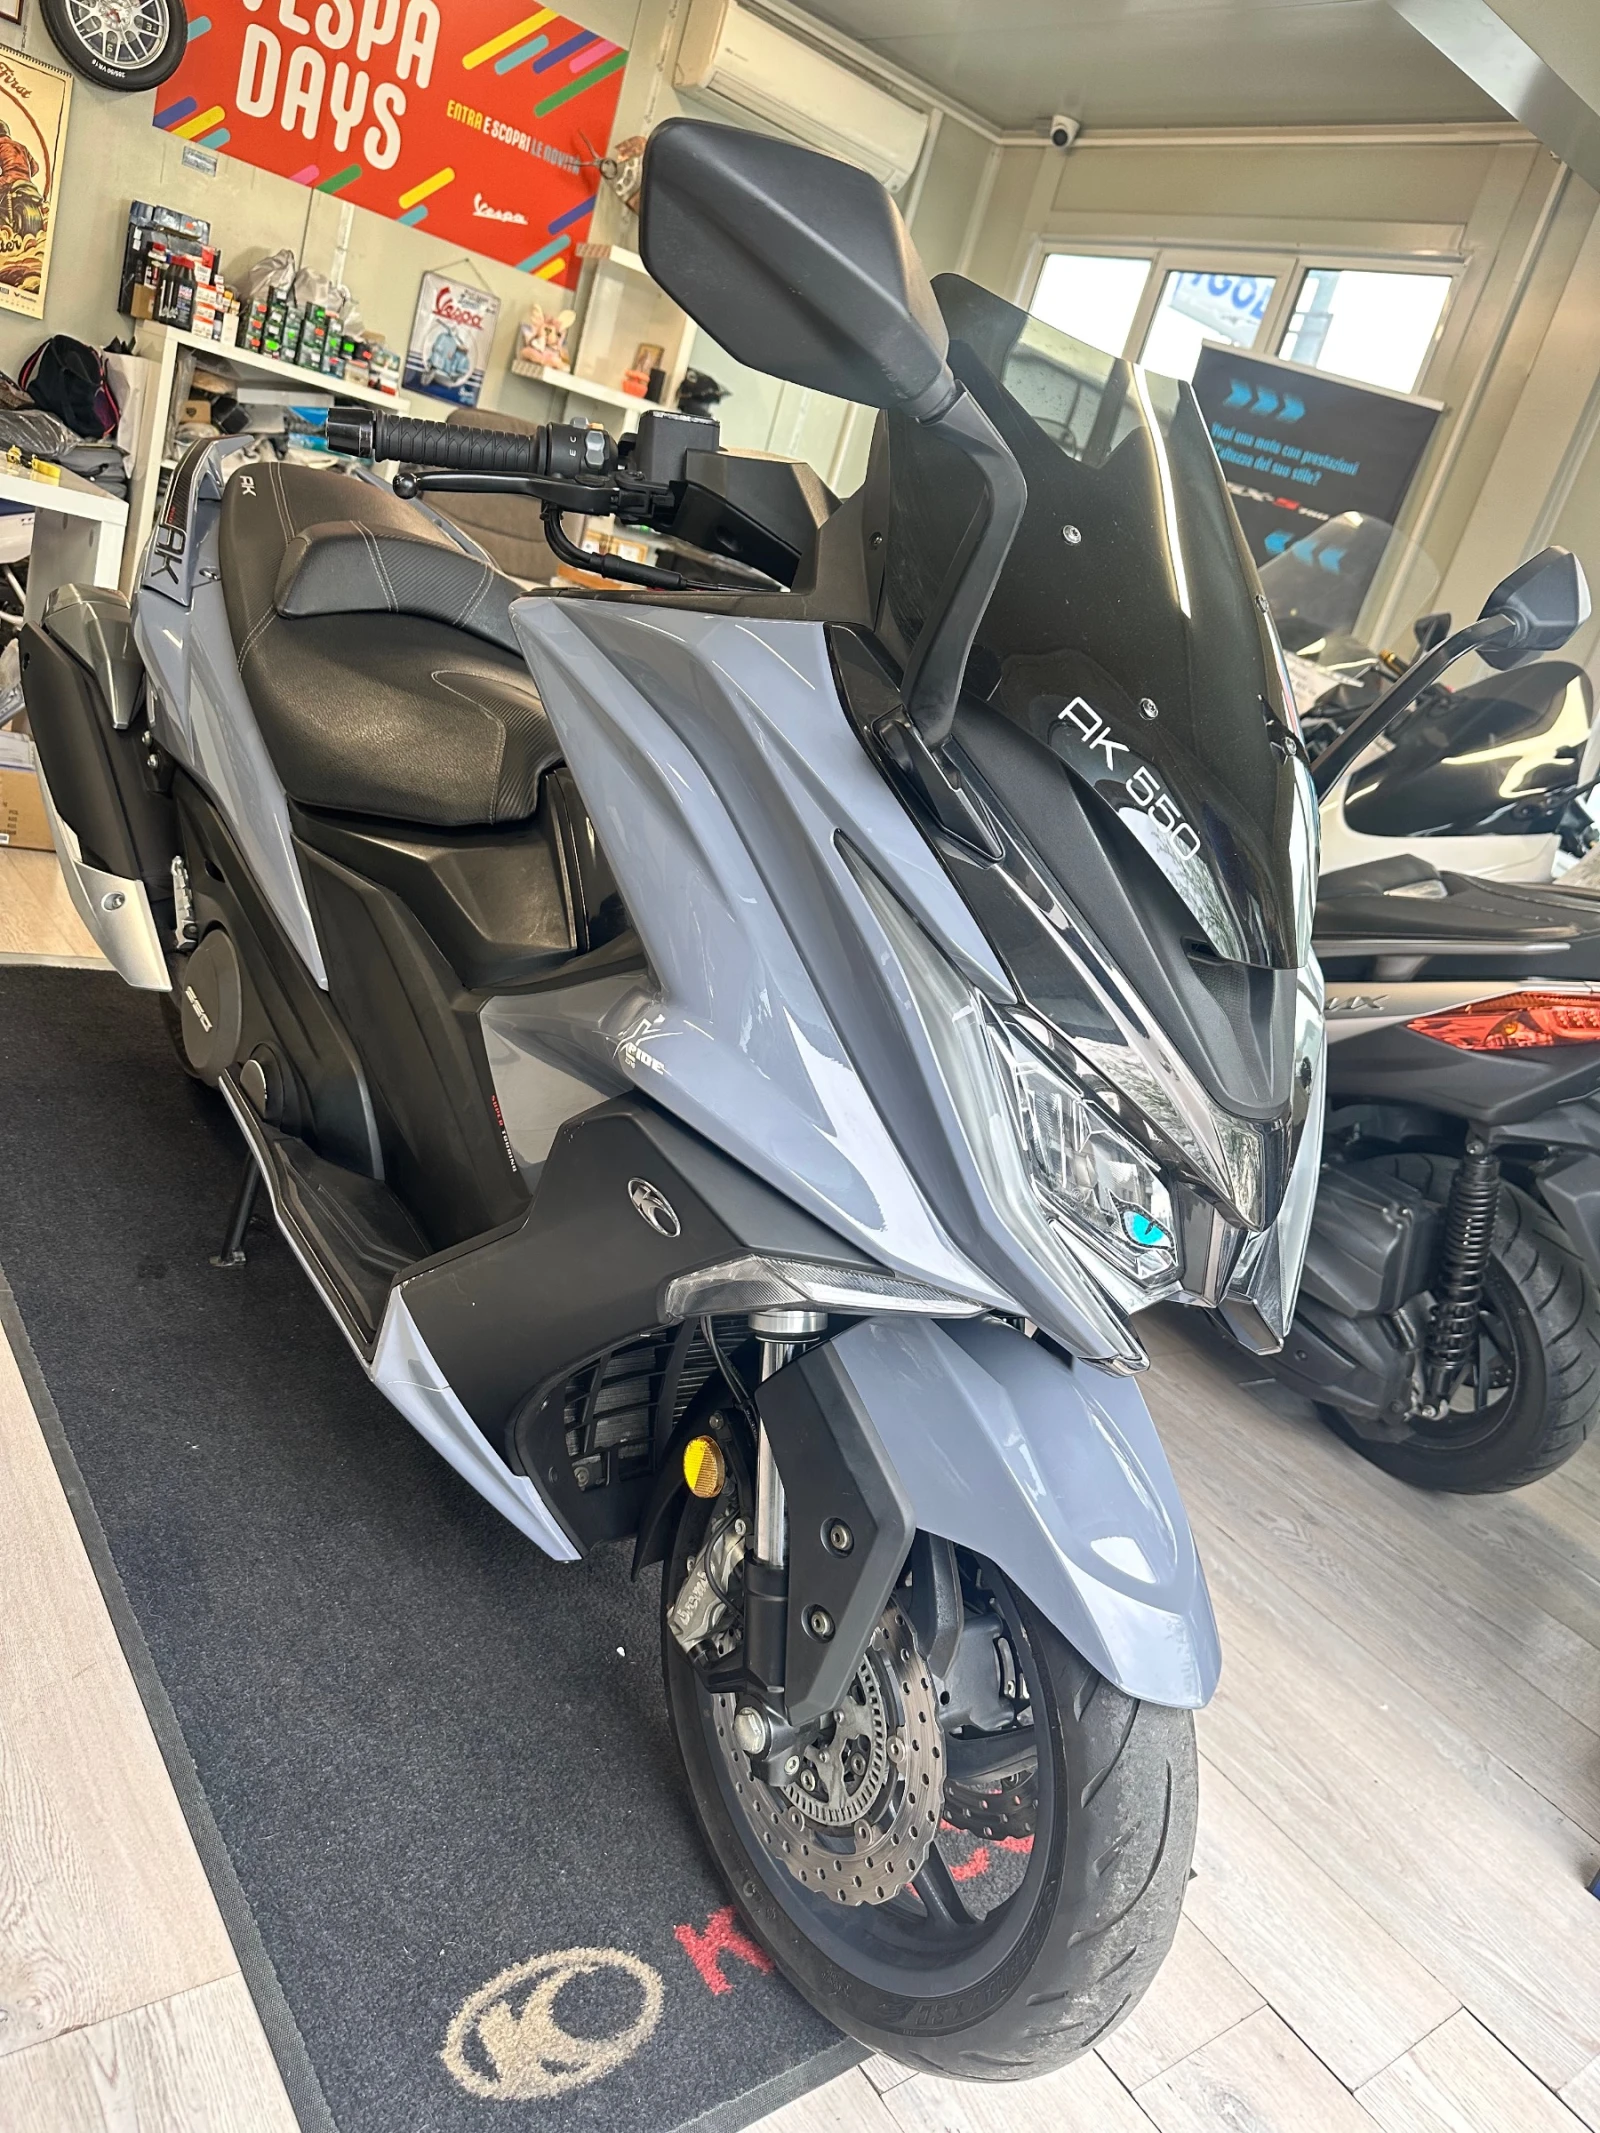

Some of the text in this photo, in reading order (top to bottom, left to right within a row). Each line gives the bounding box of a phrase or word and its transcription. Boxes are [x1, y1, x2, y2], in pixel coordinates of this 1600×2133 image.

[243, 0, 441, 89] SPA
[236, 23, 406, 170] DAYS
[446, 99, 484, 130] ENTRA
[483, 116, 492, 134] E
[491, 120, 532, 152] SCOPRI
[530, 138, 543, 158] LE
[472, 193, 529, 225] Vespa
[432, 286, 485, 330] Vespa
[1234, 430, 1255, 446] una
[1254, 436, 1282, 454] moto
[1281, 444, 1302, 459] con
[1300, 450, 1360, 476] prestazioni
[1254, 455, 1273, 472] del
[1271, 462, 1292, 478] suo
[240, 475, 257, 497] AK
[151, 524, 188, 585] AK
[1057, 696, 1201, 860] AK 550
[185, 985, 213, 1032] 550
[626, 1042, 665, 1075] RIDE
[501, 1130, 517, 1172] TOURING
[677, 1571, 708, 1626] bremb
